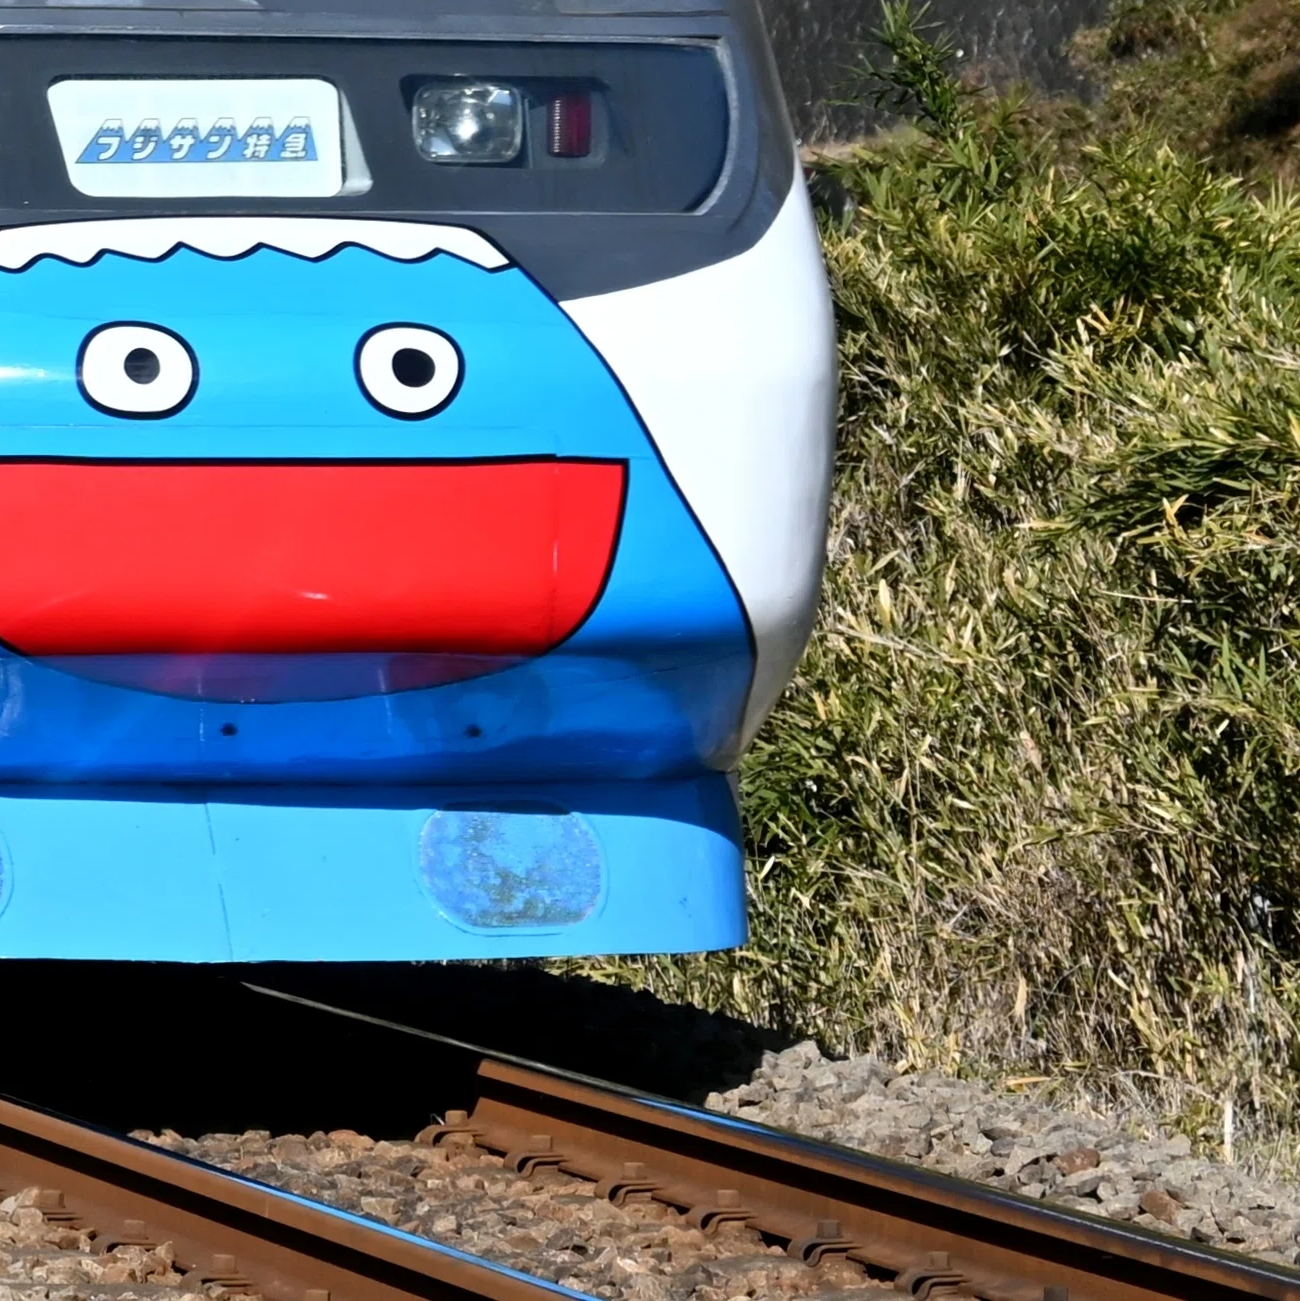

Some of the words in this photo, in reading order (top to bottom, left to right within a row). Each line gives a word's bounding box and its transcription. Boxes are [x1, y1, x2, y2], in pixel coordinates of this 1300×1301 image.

[95, 132, 308, 161] フジサン特急
